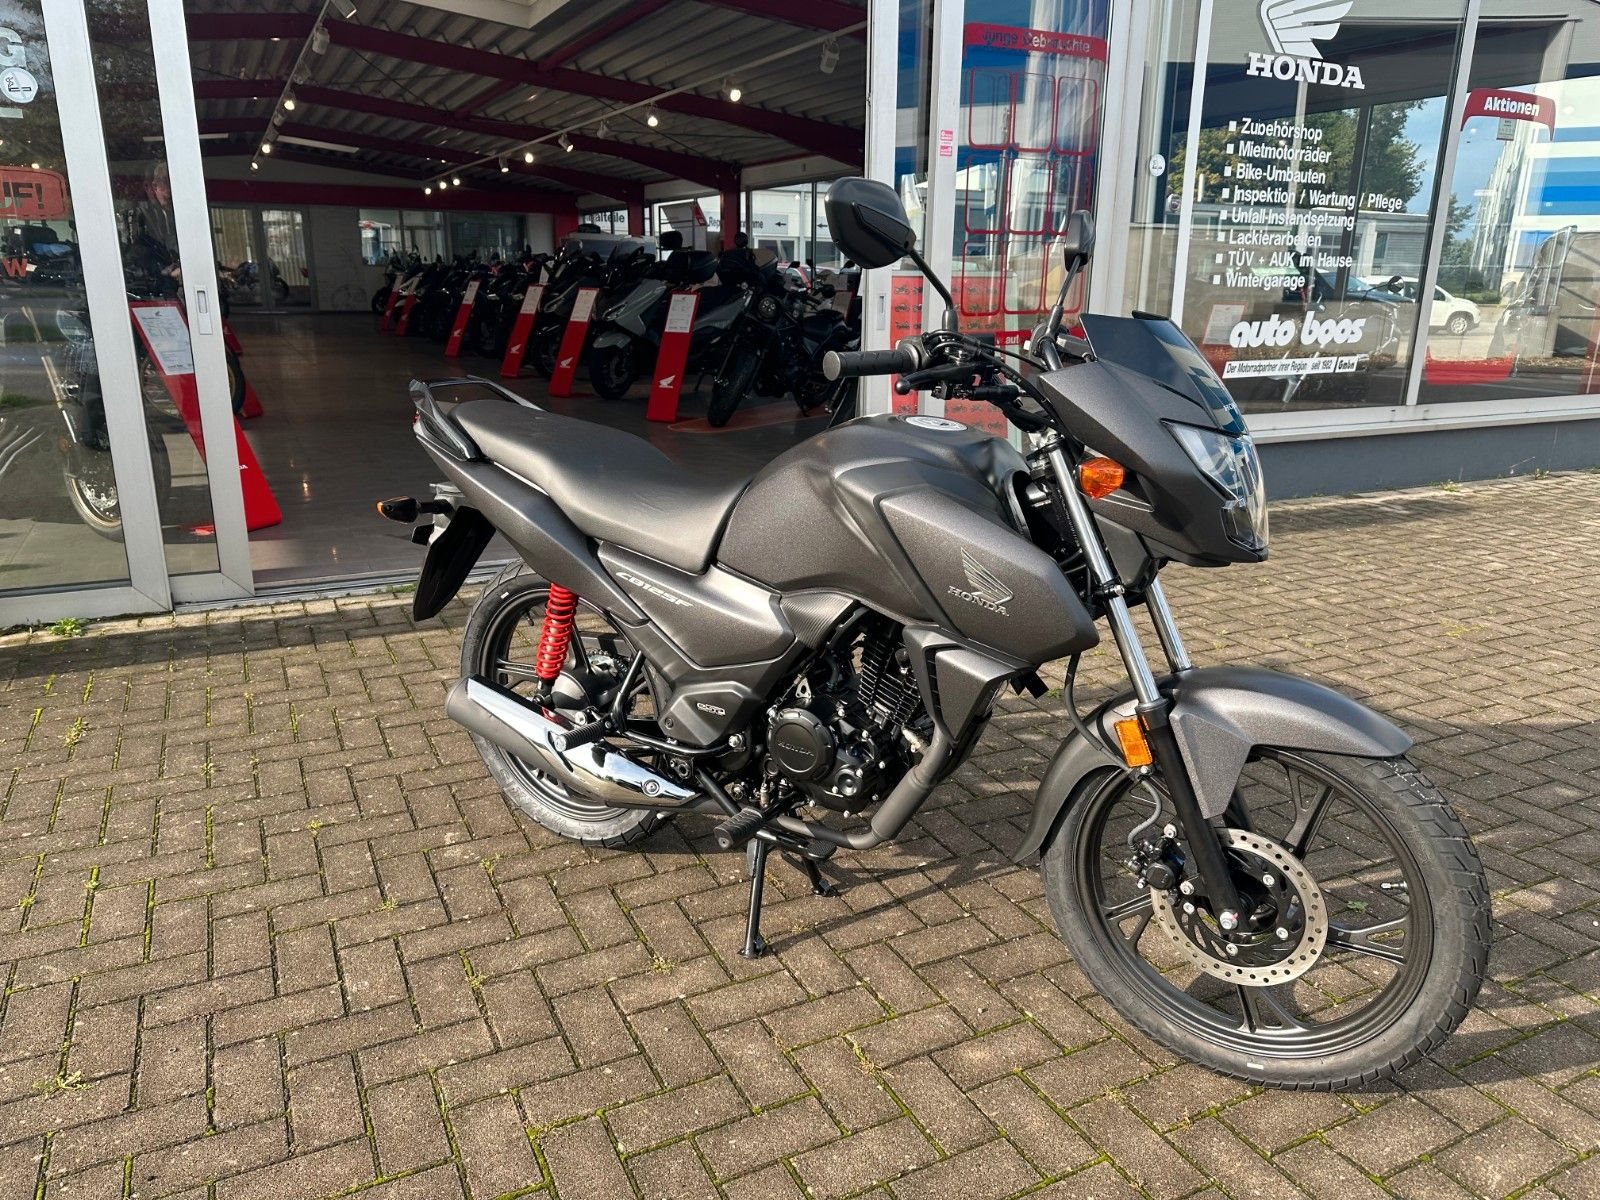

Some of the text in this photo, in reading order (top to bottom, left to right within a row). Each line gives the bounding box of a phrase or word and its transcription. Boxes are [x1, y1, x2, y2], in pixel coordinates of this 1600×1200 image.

[1246, 51, 1366, 90] HONDA
[1483, 96, 1540, 117] Aktionen
[1240, 117, 1323, 145] Zubehörshop
[1238, 140, 1333, 163] Mietmotorräder
[1236, 162, 1326, 184] Bike-Umbauten
[1233, 185, 1296, 205] Inspektion
[1308, 189, 1356, 211] Wartung
[1367, 193, 1403, 214] Pflege
[1231, 207, 1355, 231] Unfall-Instandsetzung
[1228, 229, 1322, 247] Lackierarbeiten
[1228, 249, 1254, 268] TÜV
[1269, 252, 1296, 267] AUK
[1299, 253, 1314, 268] im
[1317, 252, 1353, 268] Hause
[1226, 271, 1306, 291] Wintergarage
[1229, 311, 1367, 348] auto boos
[1226, 363, 1237, 374] Der
[1311, 360, 1321, 370] seit
[616, 571, 694, 607] CB125F
[947, 585, 1010, 616] HONDA
